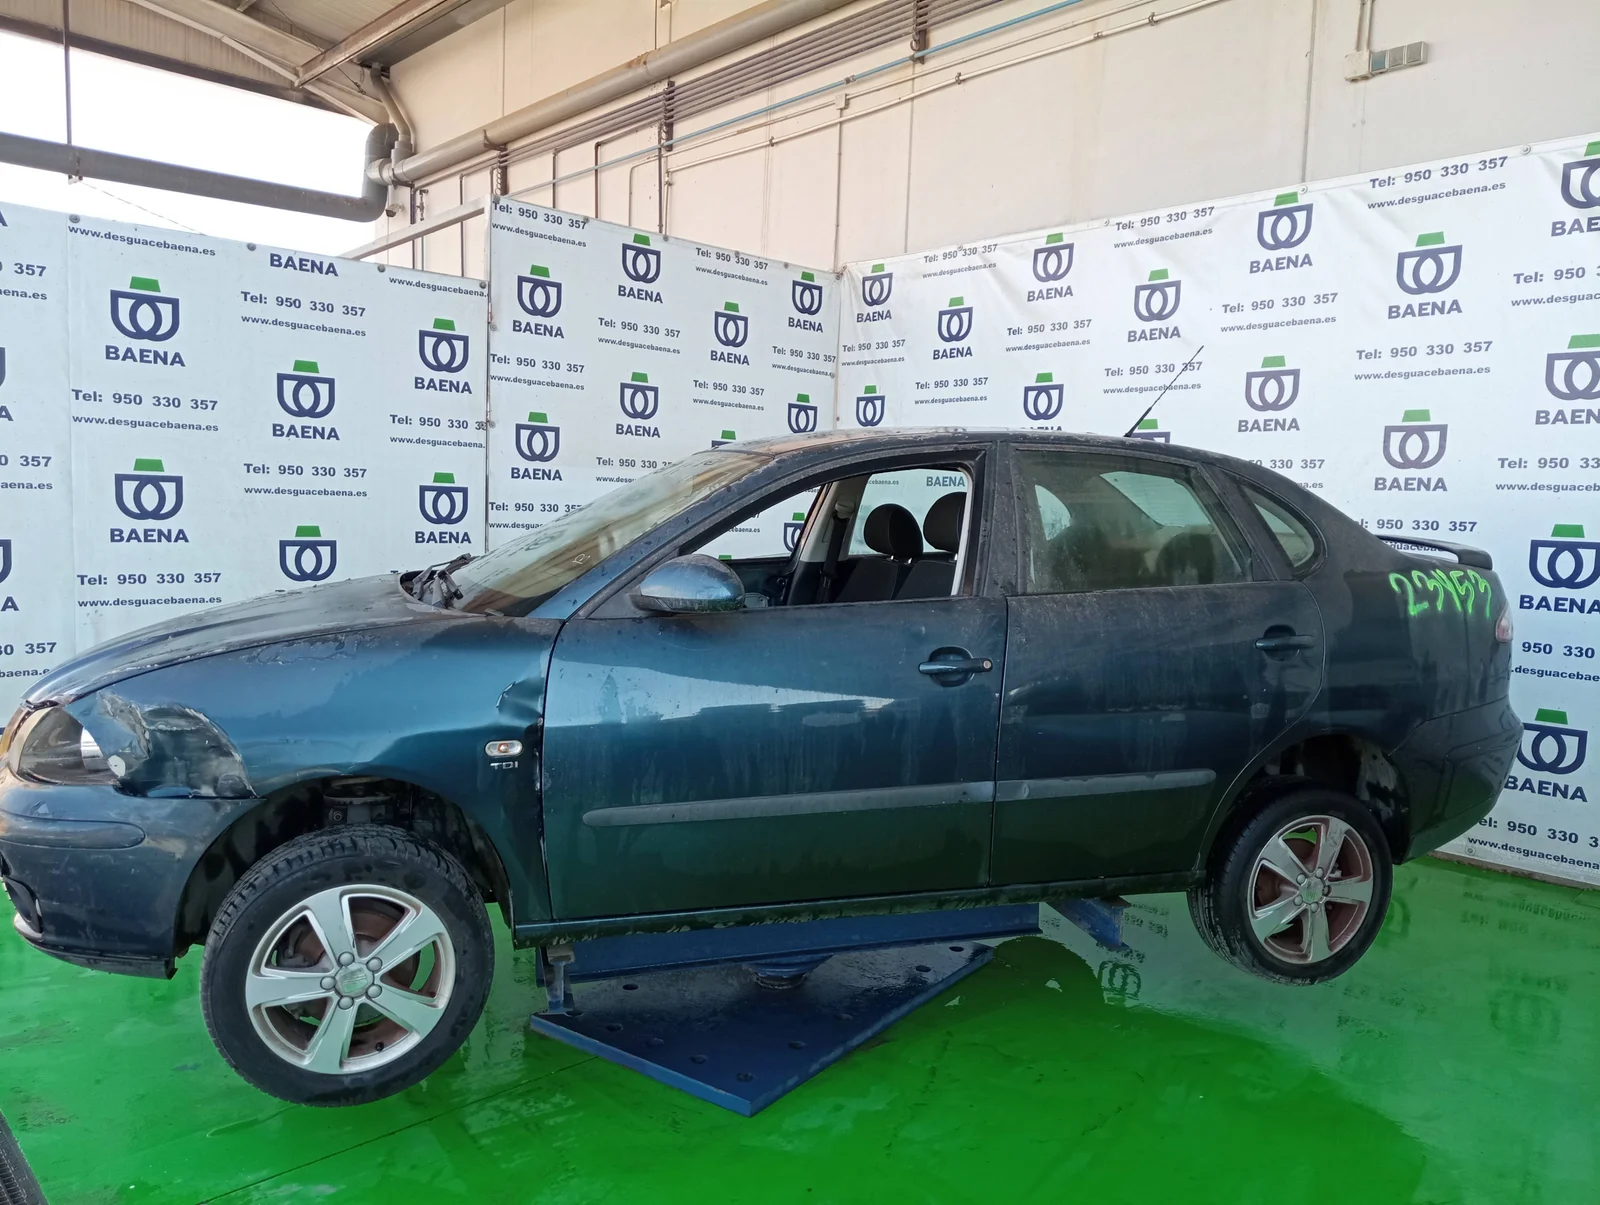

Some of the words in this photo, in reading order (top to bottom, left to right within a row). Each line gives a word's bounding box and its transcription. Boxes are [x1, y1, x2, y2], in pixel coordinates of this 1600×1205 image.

[1370, 176, 1395, 188] Tel:
[1404, 169, 1432, 183] 950
[1440, 163, 1469, 177] 330
[1478, 156, 1508, 171] 357
[1368, 182, 1506, 209] www.desguacebaena.es
[493, 202, 512, 214] Tel:
[518, 207, 538, 220] 950
[544, 213, 562, 225] 330
[568, 218, 587, 230] 357
[1115, 220, 1134, 231] Tel:
[1140, 216, 1160, 227] 950
[1166, 211, 1187, 223] 330
[1194, 206, 1214, 218] 357
[1551, 216, 1600, 236] BAE
[68, 226, 216, 256] www.desguacebaena.es
[492, 222, 586, 248] www.desguacebaena.es
[1114, 228, 1212, 248] www.desguacebaena.es
[696, 247, 711, 258] Tel:
[716, 252, 731, 262] 950
[734, 255, 750, 266] 330
[754, 260, 768, 270] 357
[924, 254, 938, 263] Tel:
[942, 250, 958, 260] 950
[962, 246, 978, 257] 330
[982, 244, 998, 254] 357
[14, 263, 46, 276] 357
[270, 253, 338, 276] BAENA
[922, 263, 996, 278] www.desguacebaena.es
[1250, 254, 1313, 274] BAENA
[696, 266, 768, 286] www.desguacebaena.es
[1513, 272, 1544, 284] Tel:
[1554, 267, 1586, 280] 950
[389, 277, 489, 298] www.desguacebaena.
[618, 285, 663, 304] BAENA
[1027, 285, 1073, 302] BAENA
[241, 291, 267, 304] Tel:
[276, 296, 301, 308] 950
[310, 301, 334, 313] 330
[342, 305, 366, 317] 357
[1222, 303, 1244, 313] Tel:
[1251, 299, 1274, 310] 950
[1282, 296, 1306, 308] 330
[1314, 292, 1338, 304] 357
[1388, 299, 1462, 319] BAENA
[856, 310, 892, 323] BAENA
[1220, 316, 1336, 332] www.desguacebaena.es
[241, 316, 366, 336] www.desguacebaena.es
[512, 320, 564, 338] BAENA
[598, 317, 616, 328] Tel:
[621, 321, 638, 332] 950
[643, 325, 660, 335] 330
[664, 328, 680, 338] 357
[788, 317, 823, 333] BAENA
[1007, 327, 1022, 336] Tel:
[1028, 324, 1045, 334] 950
[1050, 322, 1068, 331] 330
[1074, 319, 1092, 329] 357
[1128, 326, 1181, 342] BAENA
[598, 338, 680, 354] www.desguacebaena.es
[842, 344, 855, 352] Tel:
[858, 343, 872, 351] 950
[876, 341, 888, 350] 330
[892, 339, 906, 348] 357
[933, 346, 972, 360] BAENA
[1006, 340, 1090, 352] www.desguacebaena.es
[1356, 349, 1382, 360] Tel:
[1390, 346, 1417, 358] 950
[1426, 344, 1454, 356] 330
[1464, 341, 1492, 353] 357
[106, 345, 186, 367] BAENA
[710, 350, 750, 366] BAENA
[772, 346, 786, 355] Tel:
[790, 349, 803, 358] 950
[807, 352, 820, 360] 330
[823, 354, 836, 363] 357
[842, 357, 904, 366] www.desguacebaena.es
[490, 354, 510, 365] Tel:
[516, 357, 536, 368] 950
[542, 360, 560, 370] 330
[566, 363, 584, 373] 357
[1104, 368, 1123, 376] Tel:
[1129, 365, 1149, 375] 950
[1155, 364, 1175, 374] 330
[1182, 361, 1202, 372] 357
[1354, 367, 1490, 380] www.desguacebaena.es
[415, 376, 472, 394] BAENA
[490, 374, 585, 390] www.desguacebaena.es
[693, 380, 708, 389] Tel:
[713, 382, 728, 391] 950
[732, 384, 746, 394] 330
[750, 387, 764, 396] 357
[915, 382, 930, 390] Tel:
[934, 380, 949, 388] 950
[953, 378, 968, 387] 330
[973, 377, 988, 386] 357
[1103, 383, 1201, 394] www.desguacebaena.es
[72, 389, 102, 402] Tel:
[112, 393, 142, 405] 950
[152, 396, 181, 408] 330
[190, 399, 218, 410] 357
[693, 398, 764, 411] www.desguacebaena.es
[914, 396, 987, 404] www.desguacebaena.es
[72, 416, 218, 431] www.desguacebaena.es
[390, 414, 412, 425] Tel:
[419, 417, 441, 427] 950
[448, 419, 468, 429] 330
[1535, 408, 1600, 425] BAEN
[272, 424, 340, 440] BAENA
[616, 424, 660, 438] BAENA
[1238, 418, 1300, 432] BAENA
[20, 455, 52, 467] 357
[596, 457, 614, 466] Tel:
[619, 458, 636, 468] 950
[641, 460, 657, 469] 330
[1270, 459, 1293, 469] 330
[1300, 459, 1325, 469] 357
[1498, 458, 1528, 468] Tel:
[1538, 458, 1569, 468] 950
[1580, 457, 1600, 469] 33
[244, 463, 270, 474] Tel:
[278, 465, 303, 476] 950
[312, 466, 336, 477] 330
[344, 468, 367, 478] 357
[511, 467, 562, 481] BAENA
[926, 476, 965, 487] BAENA
[1374, 477, 1448, 492] BAENA
[1496, 482, 1600, 493] www.desguaceb
[244, 487, 367, 497] www.desguacebaena.es
[489, 502, 509, 511] Tel:
[514, 503, 534, 512] 950
[540, 504, 558, 512] 330
[1377, 519, 1403, 530] 950
[1412, 520, 1439, 531] 330
[1448, 521, 1477, 532] 357
[110, 528, 189, 543] BAENA
[415, 531, 472, 544] BAENA
[77, 574, 107, 585] Tel:
[117, 574, 146, 584] 950
[156, 573, 184, 584] 330
[194, 573, 221, 583] 357
[78, 596, 222, 607] www.desguacebaena.es
[25, 642, 57, 654] 357
[1522, 642, 1552, 654] 950
[1563, 646, 1595, 658] 330
[490, 761, 518, 770] TDI
[1504, 776, 1588, 802] BAENA
[1507, 821, 1537, 836] 950
[1547, 828, 1578, 844] 330
